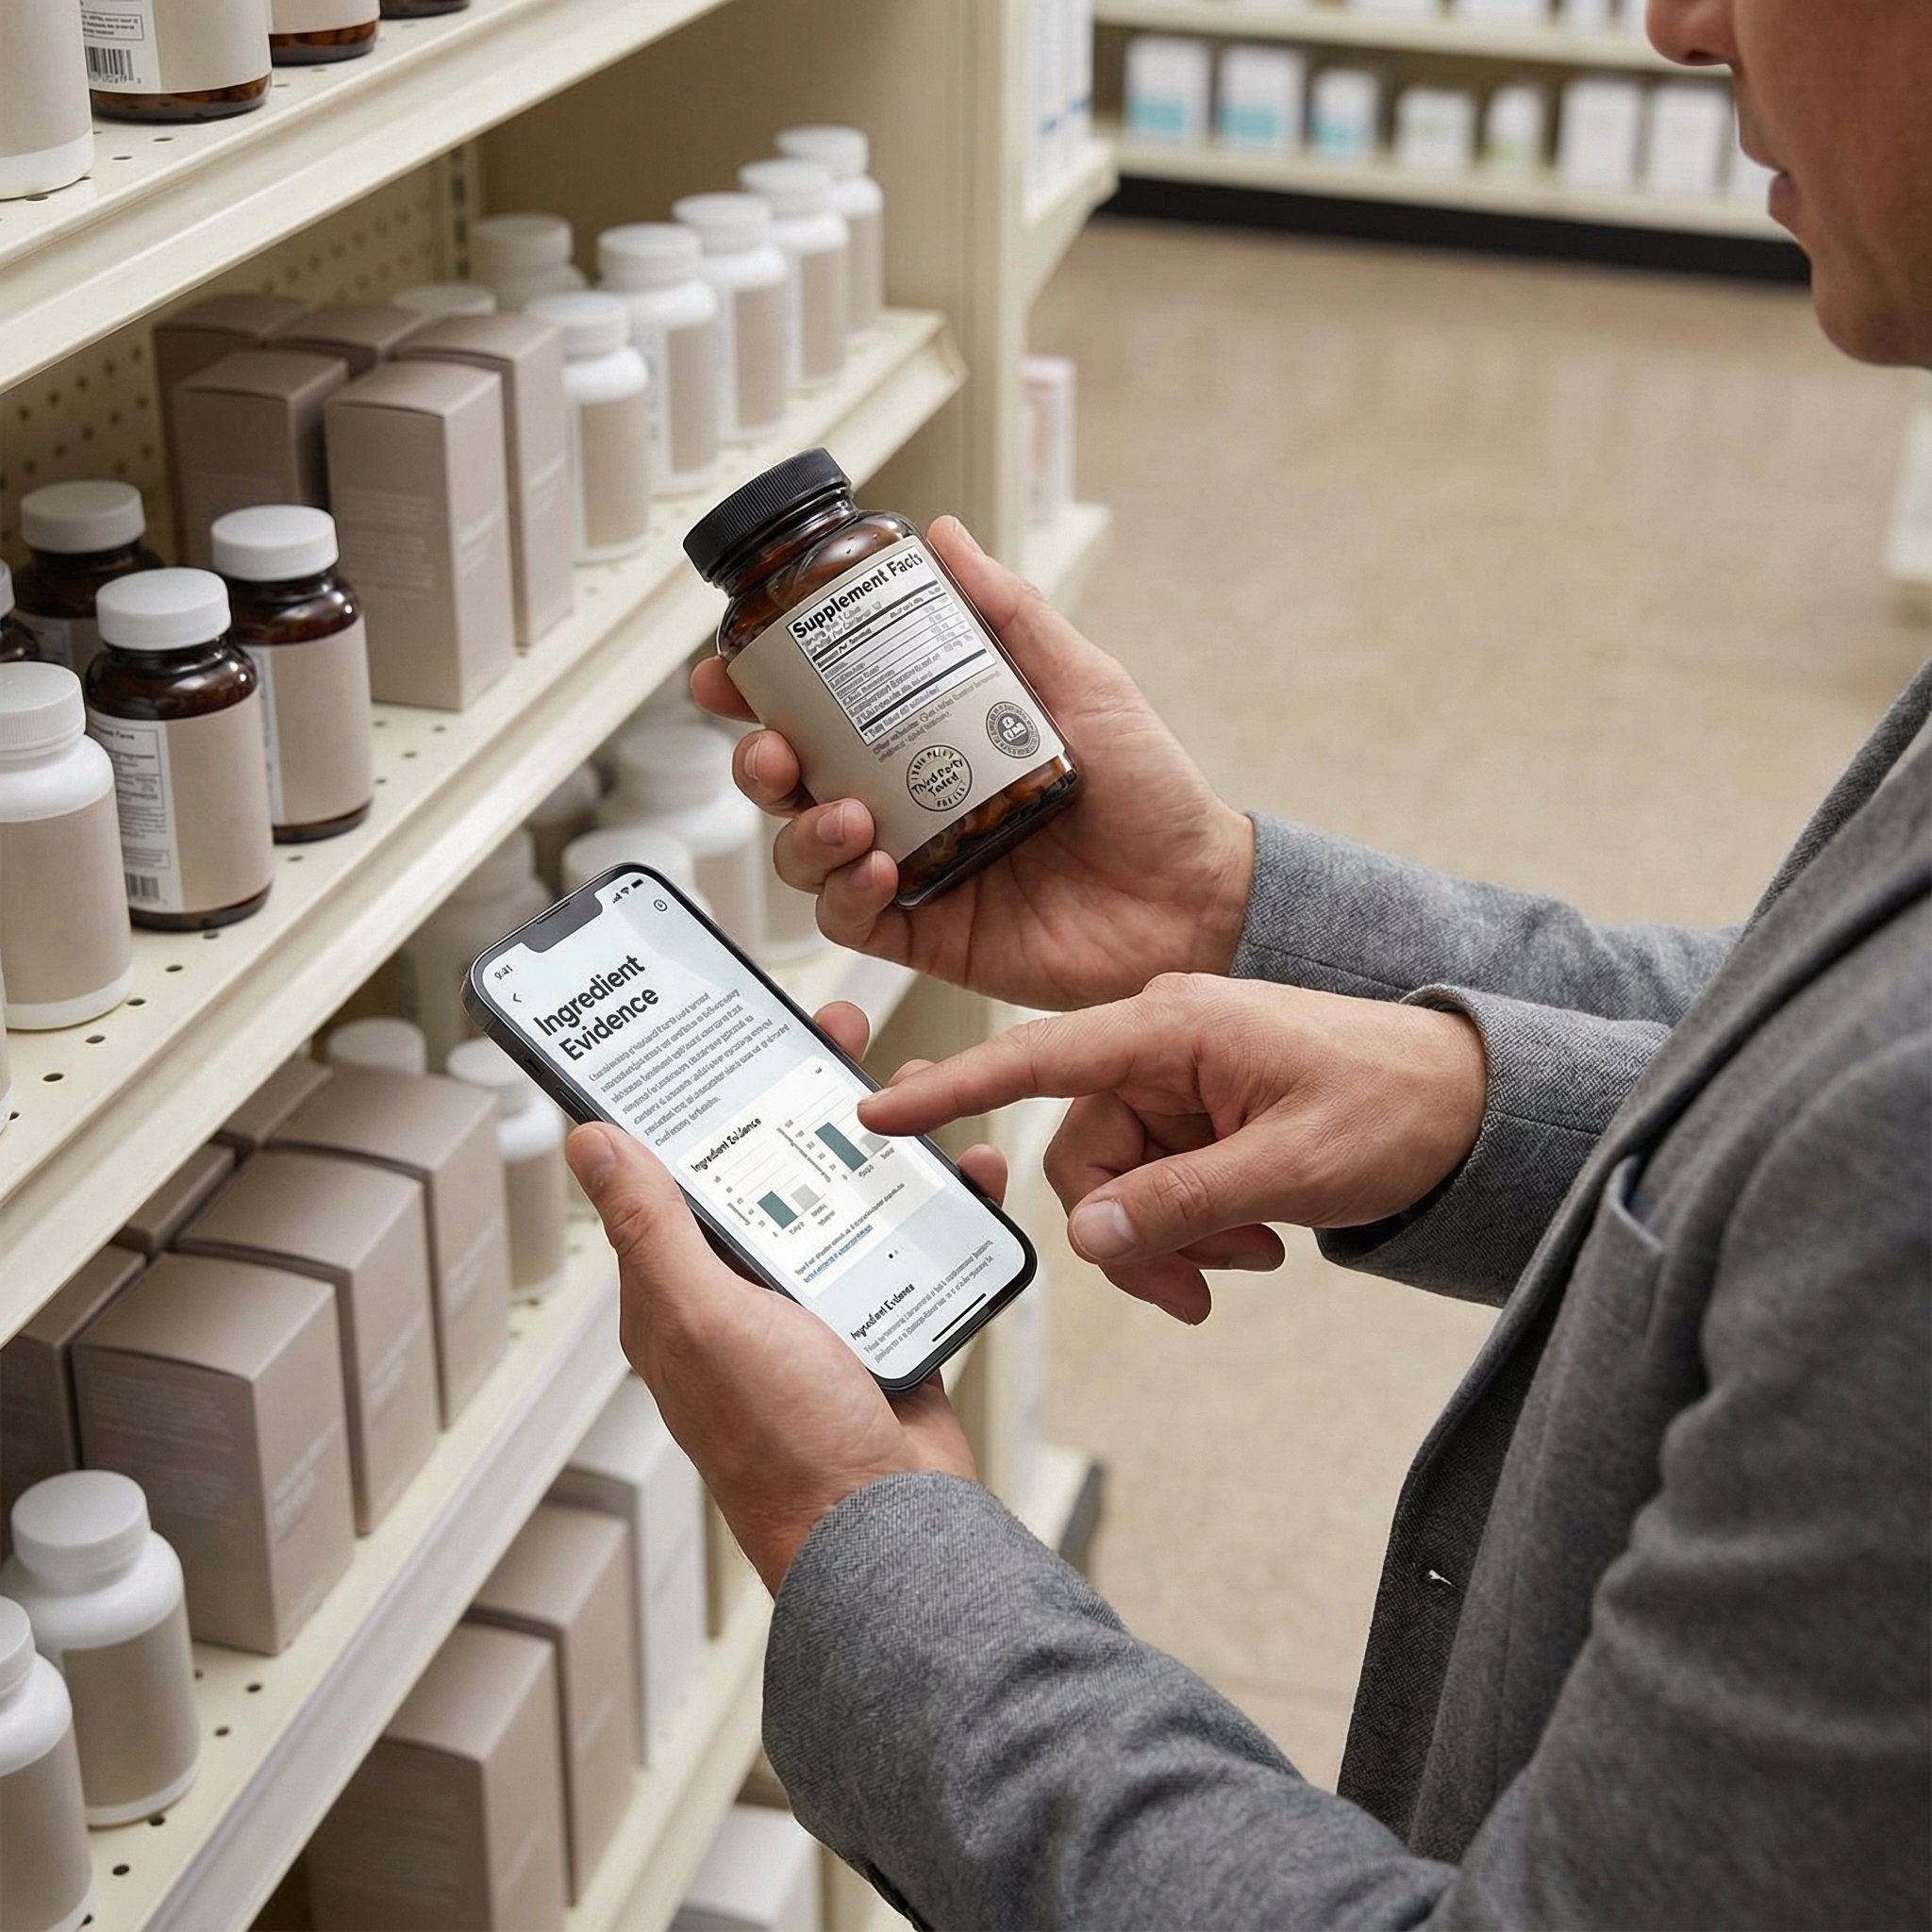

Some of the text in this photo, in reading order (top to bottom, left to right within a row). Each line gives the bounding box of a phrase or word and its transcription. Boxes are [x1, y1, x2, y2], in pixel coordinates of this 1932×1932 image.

[792, 569, 890, 639] Supplement
[886, 553, 924, 576] Facts
[533, 955, 645, 1037] Ingredient
[558, 989, 658, 1060] Evidence
